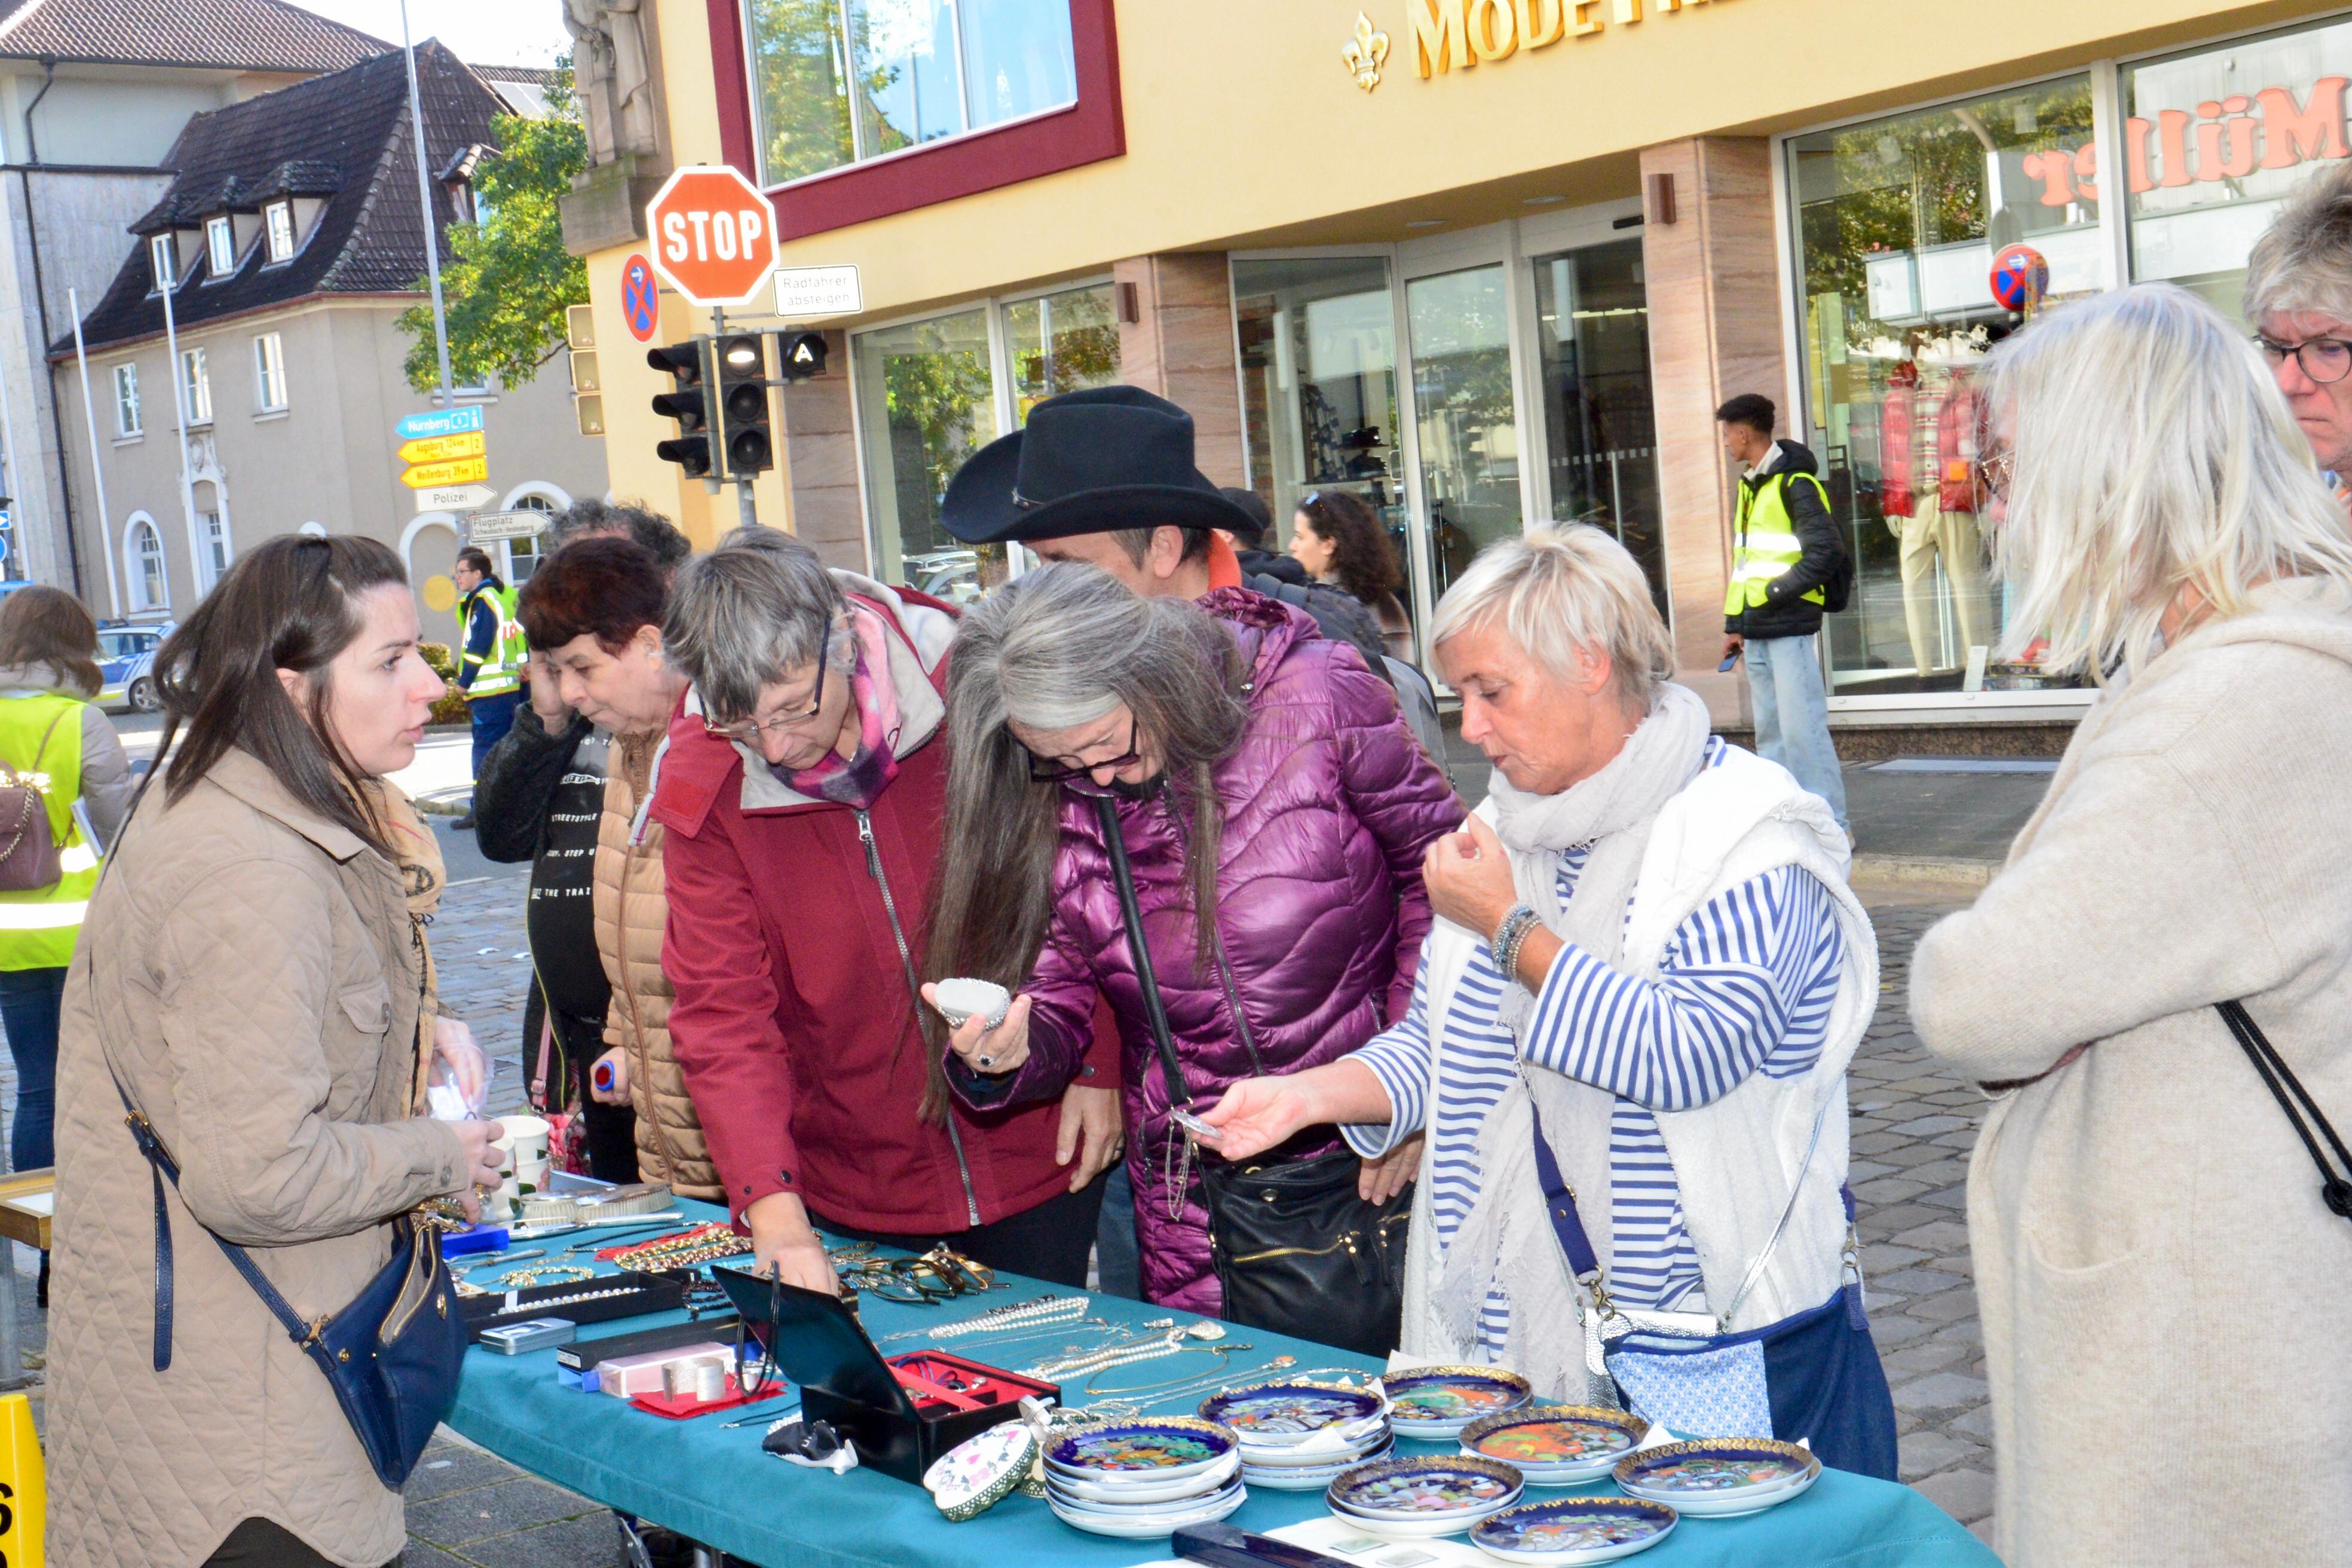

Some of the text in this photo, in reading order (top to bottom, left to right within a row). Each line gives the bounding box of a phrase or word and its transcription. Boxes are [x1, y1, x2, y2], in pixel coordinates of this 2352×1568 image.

[664, 210, 762, 262] STOP
[783, 276, 848, 289] Radfahrer
[788, 293, 849, 307] absteigen
[794, 342, 813, 363] A
[416, 441, 444, 454] Augsburg
[434, 492, 467, 504] Polizei
[474, 517, 513, 528] Flugplatz
[564, 849, 584, 858] STEP
[545, 889, 559, 898] THE
